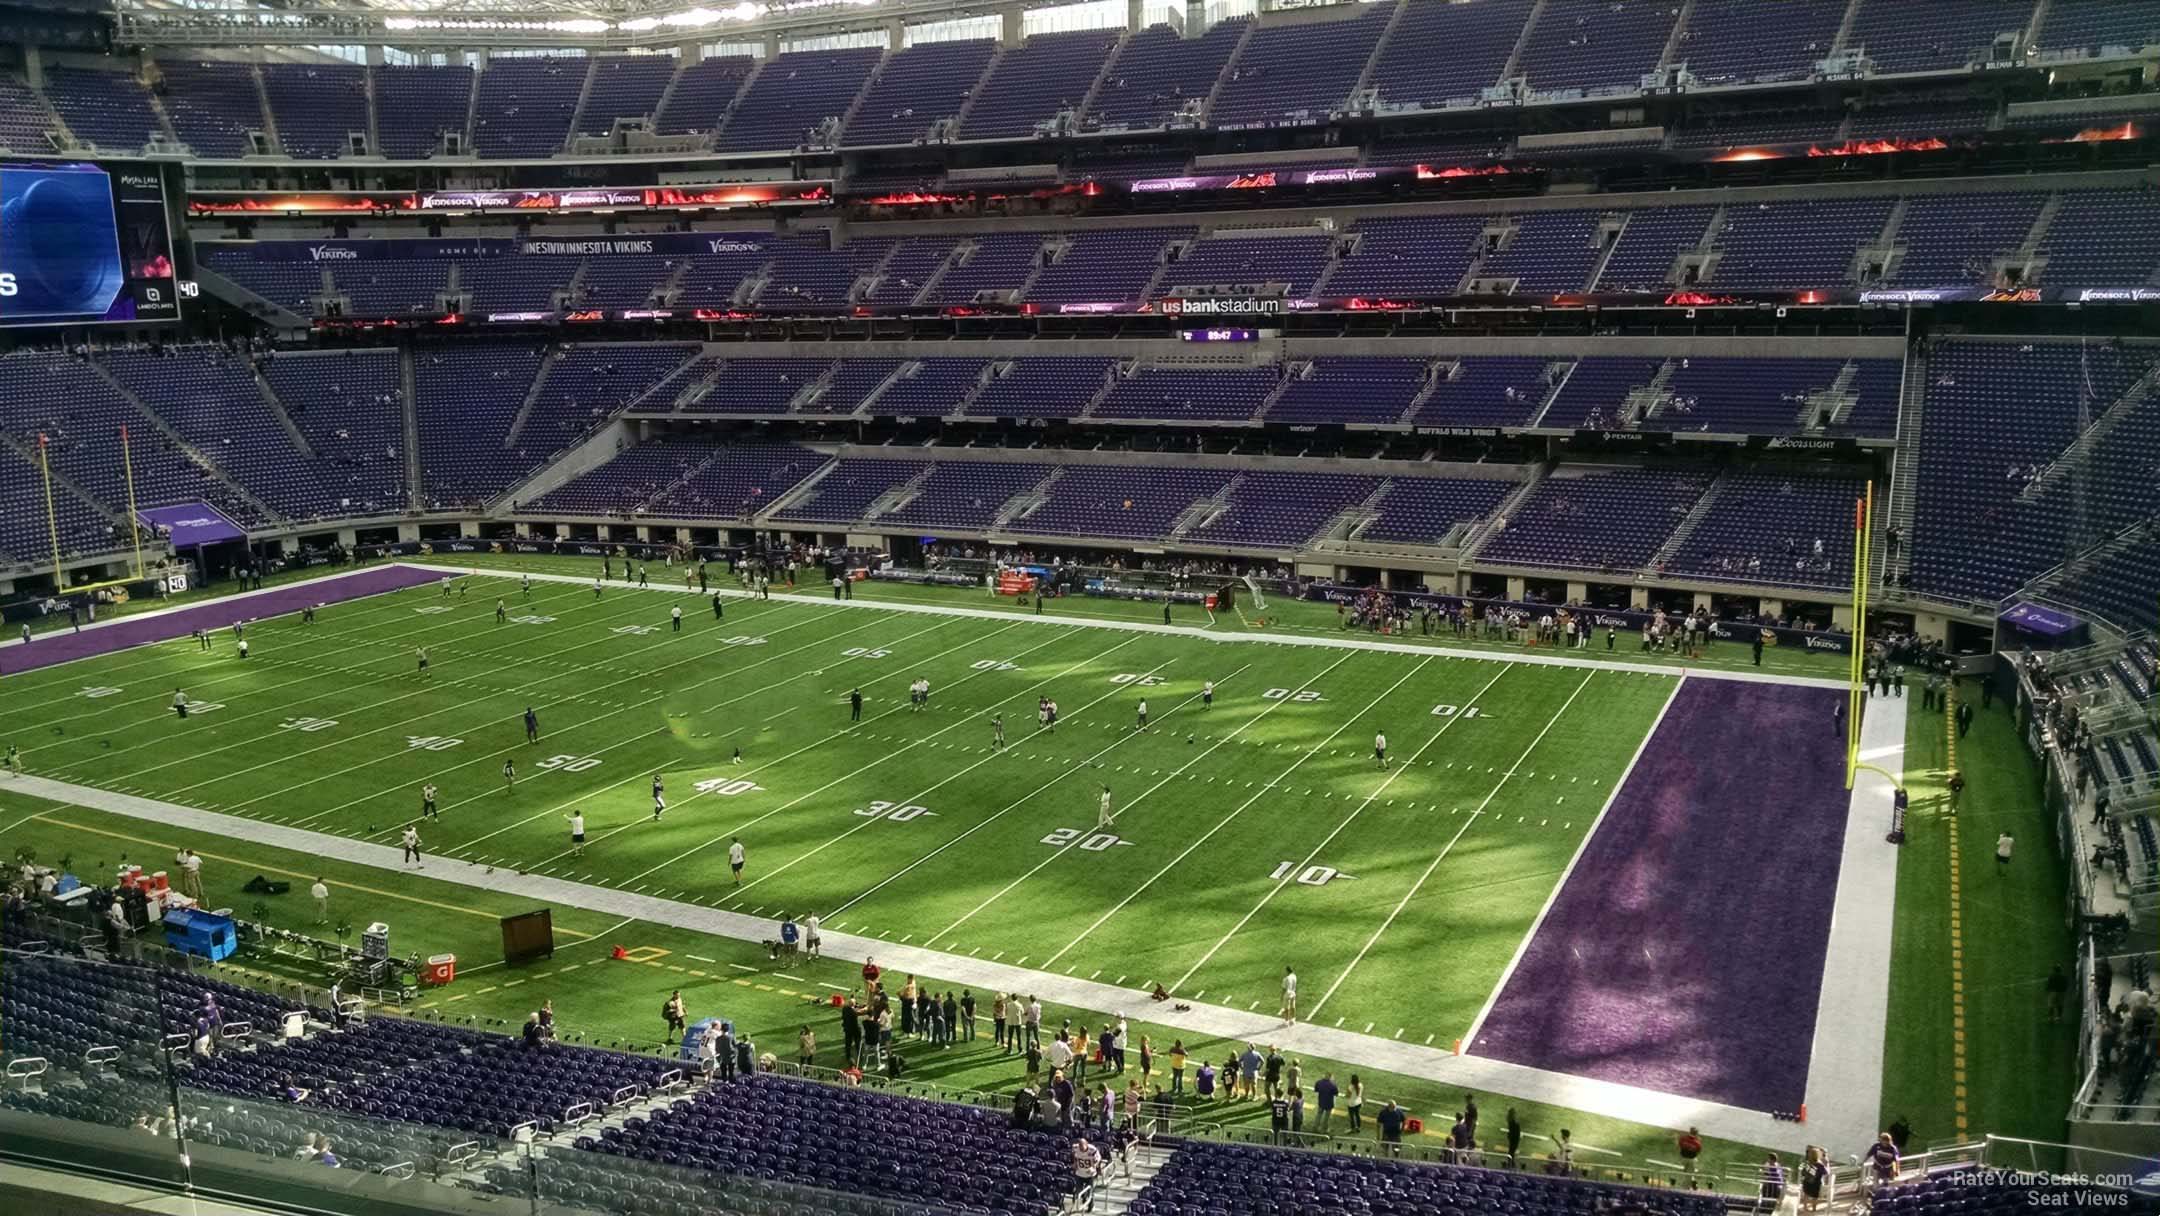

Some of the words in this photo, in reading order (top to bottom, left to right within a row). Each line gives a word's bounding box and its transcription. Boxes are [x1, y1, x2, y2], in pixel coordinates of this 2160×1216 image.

[422, 195, 473, 208] MINNESOTA
[473, 194, 509, 207] VIKINGS
[607, 193, 641, 205] VIKINGS
[614, 241, 653, 253] VIKINGS
[180, 281, 199, 297] 40
[170, 576, 186, 589] 40
[535, 754, 603, 771] 50
[692, 778, 757, 795] 40
[853, 800, 928, 822] 30
[1040, 828, 1120, 851] 20
[1269, 861, 1338, 885] 10
[436, 966, 448, 977] G
